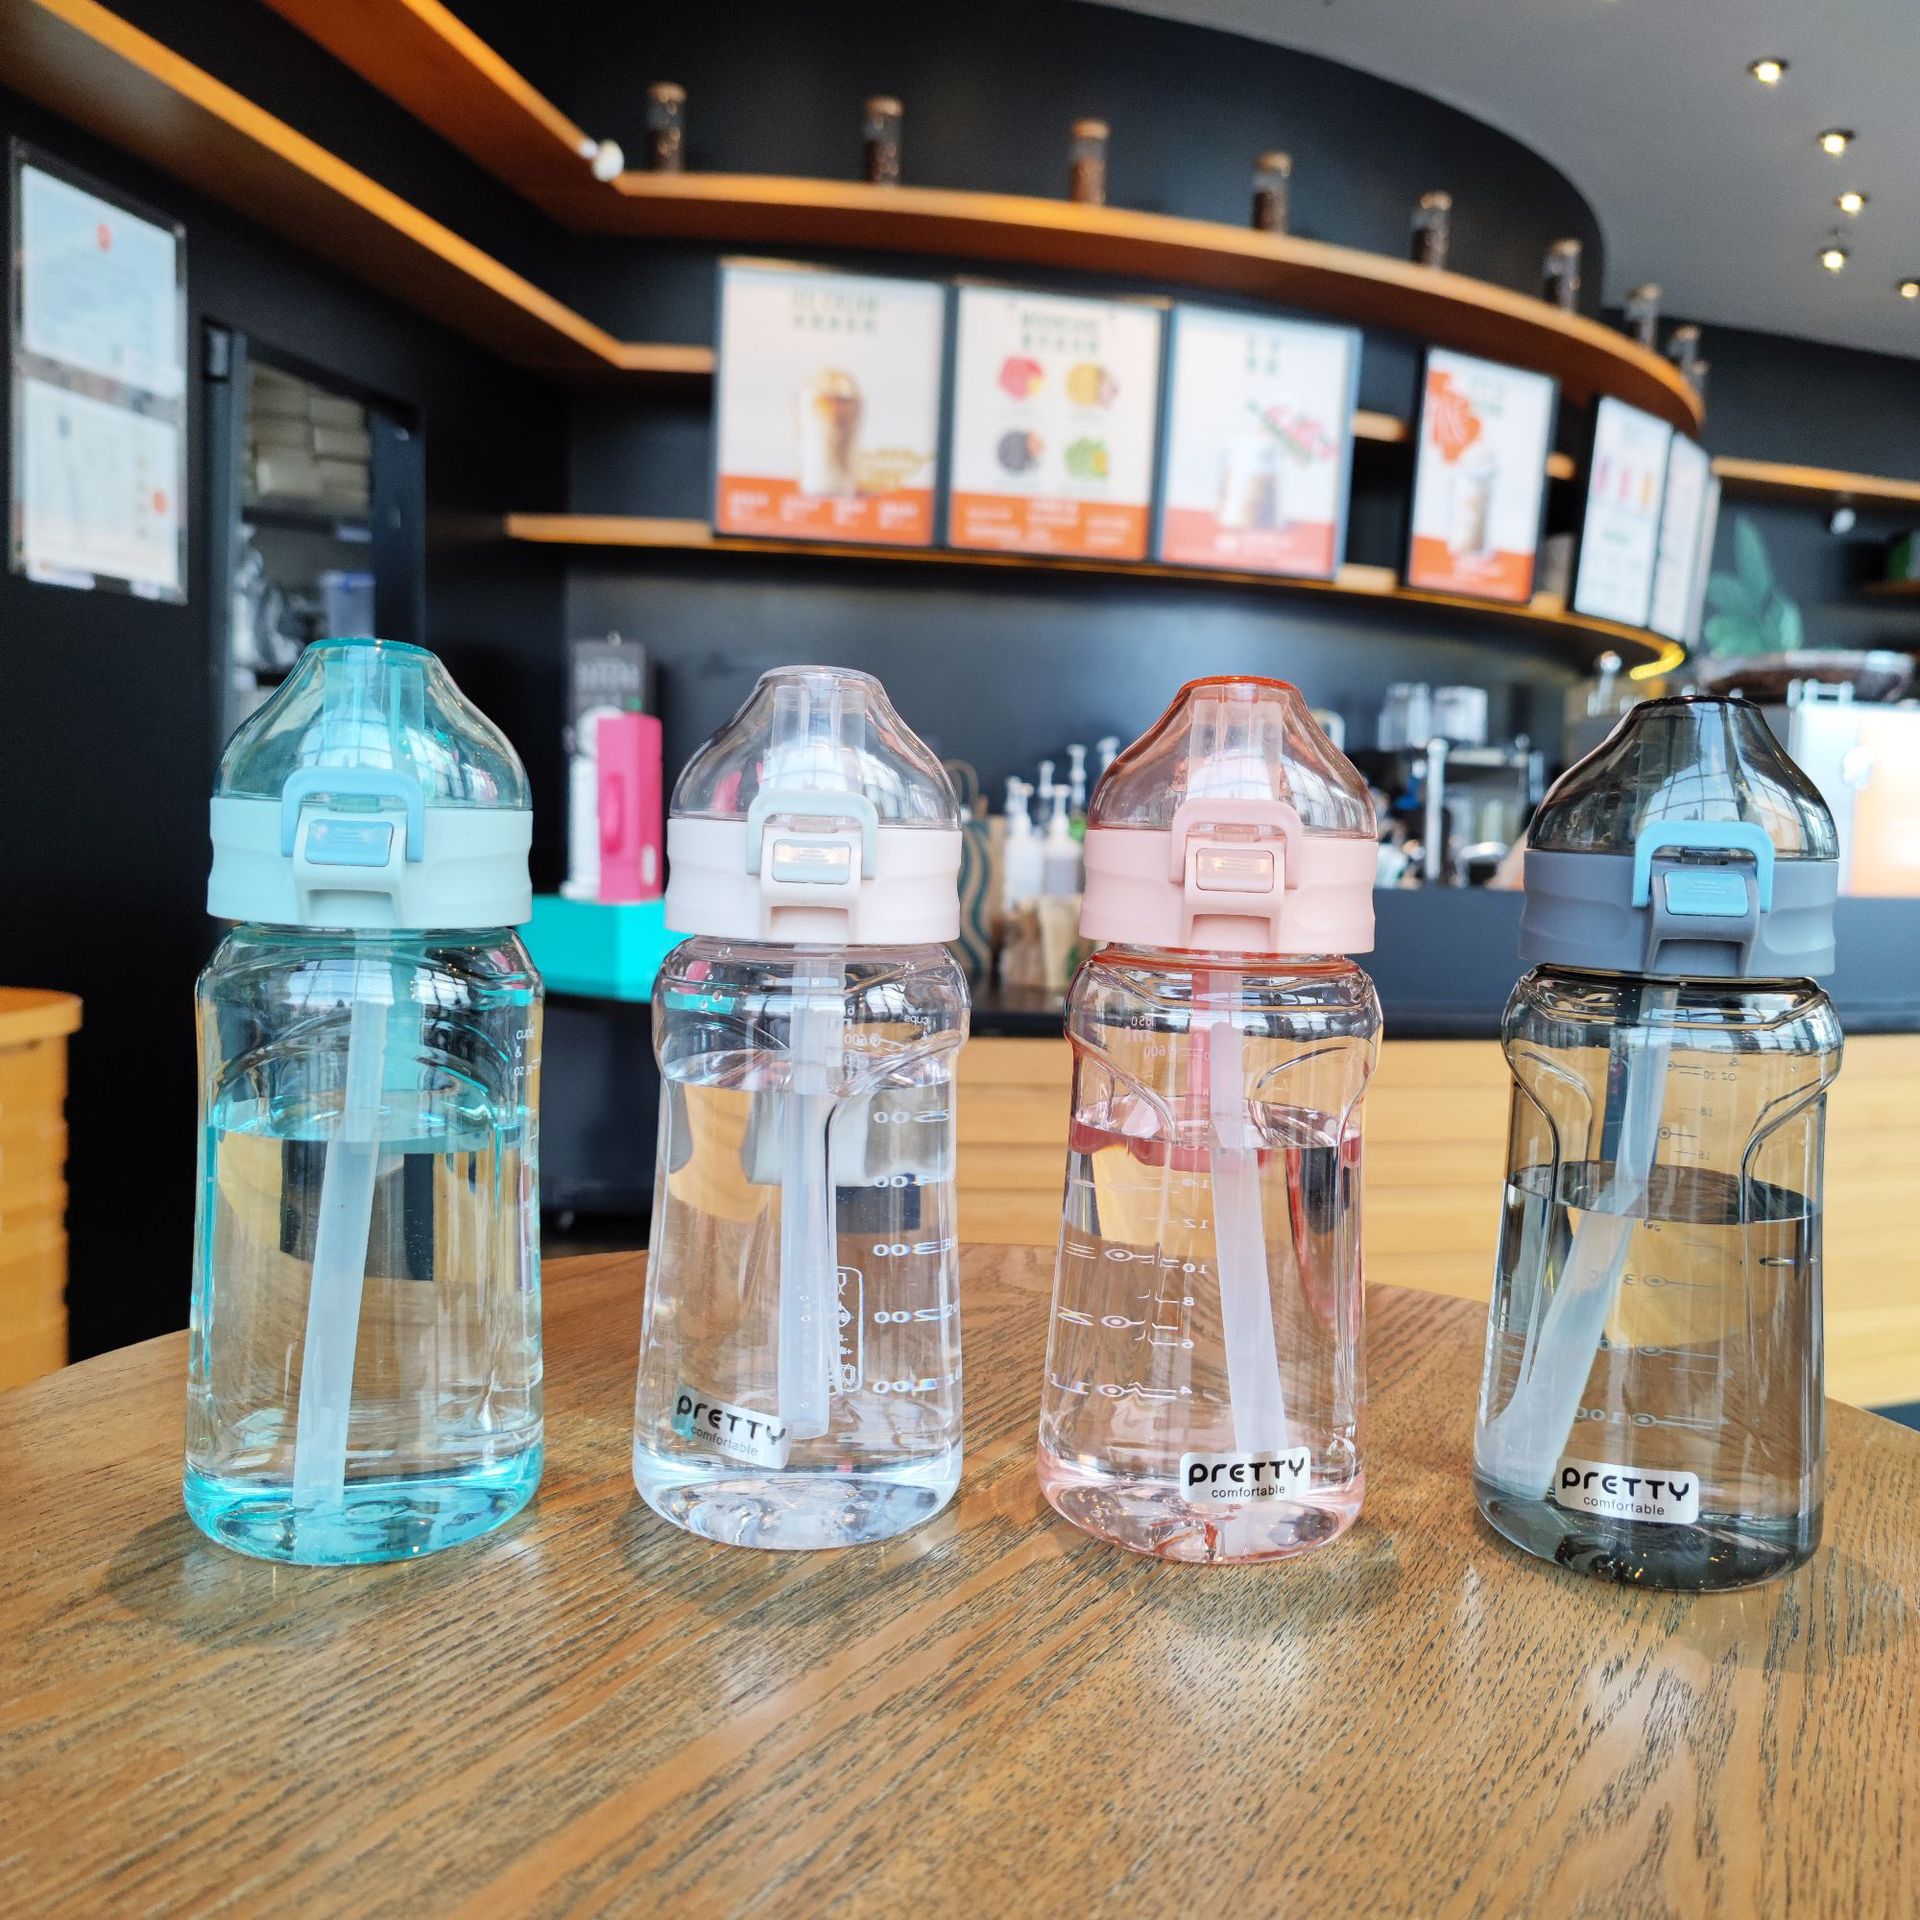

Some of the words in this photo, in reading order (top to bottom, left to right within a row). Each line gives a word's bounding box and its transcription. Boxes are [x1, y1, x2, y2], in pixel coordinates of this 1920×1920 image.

[690, 1424, 759, 1457] comfortable
[1211, 1485, 1286, 1499] comfortable
[1583, 1495, 1665, 1516] comfortable
